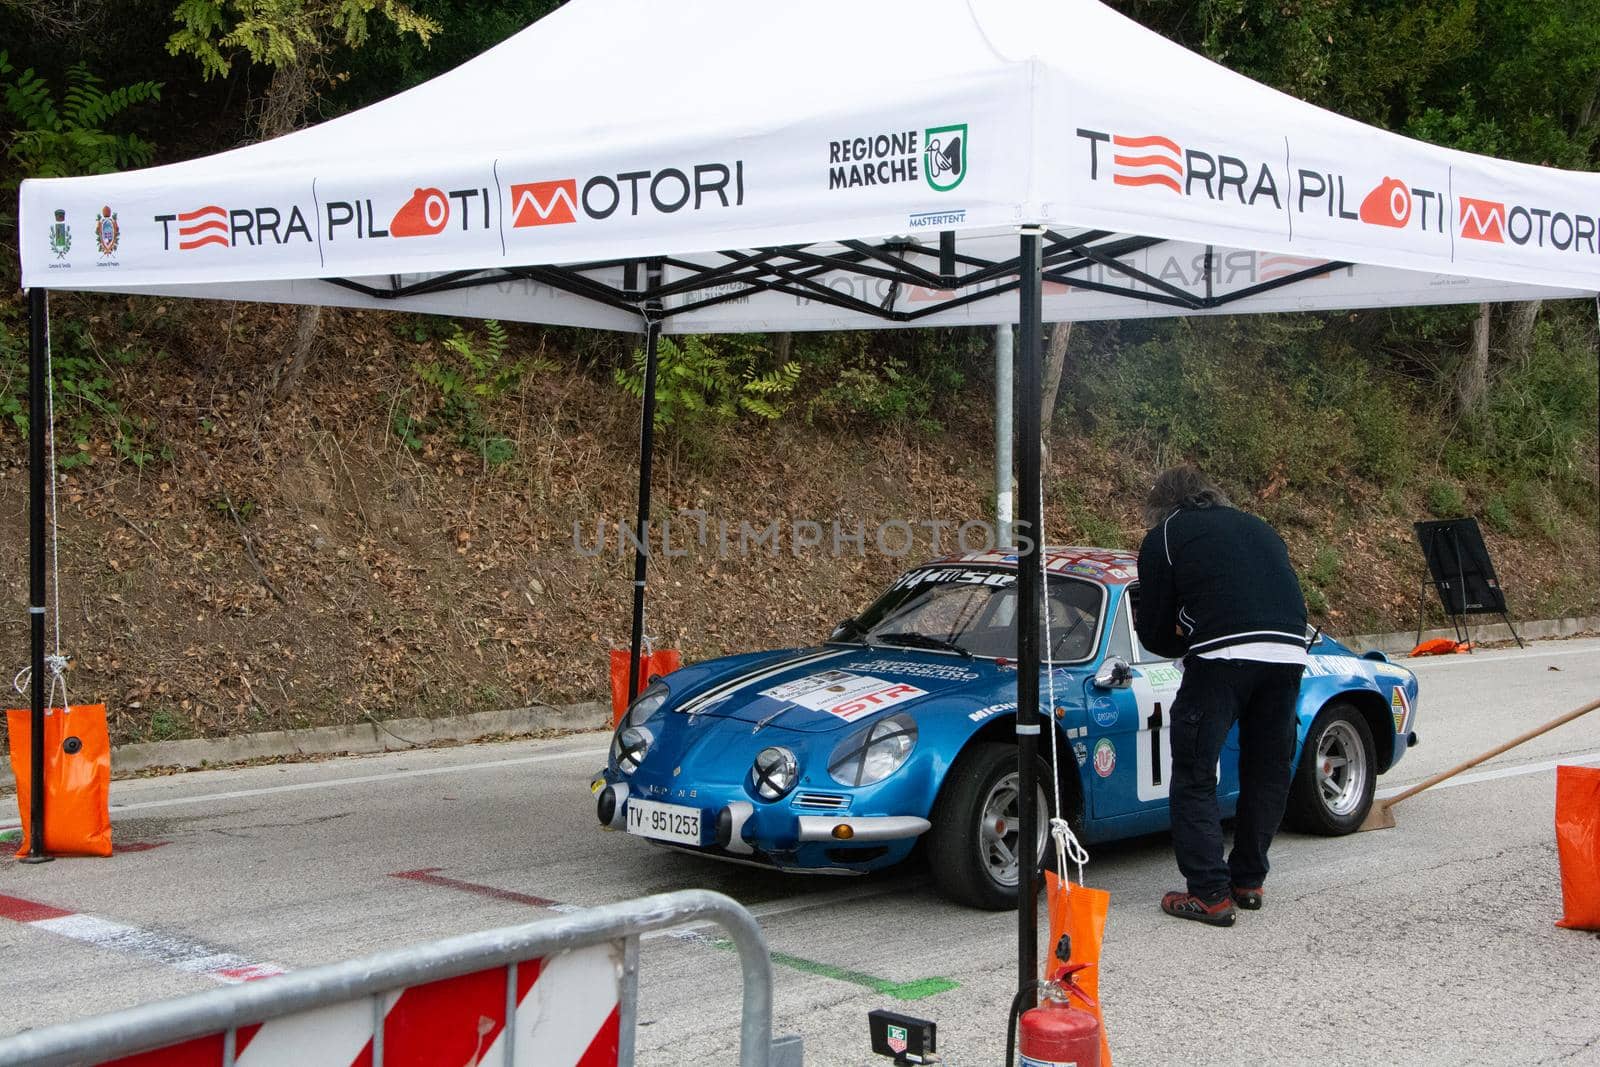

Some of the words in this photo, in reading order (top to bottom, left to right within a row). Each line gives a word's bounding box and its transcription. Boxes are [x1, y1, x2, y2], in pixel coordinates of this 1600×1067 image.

[829, 130, 918, 164] REGIONE
[829, 157, 918, 190] MARCHE
[1076, 128, 1282, 209] TERRA
[1298, 168, 1444, 233] PILOTI
[154, 205, 313, 250] TERRA
[326, 187, 490, 240] PILOTI
[510, 160, 744, 228] MOTORI
[909, 213, 966, 228] MASTERTENT
[831, 684, 919, 717] STR
[629, 806, 643, 827] TV
[651, 810, 699, 837] 951253
